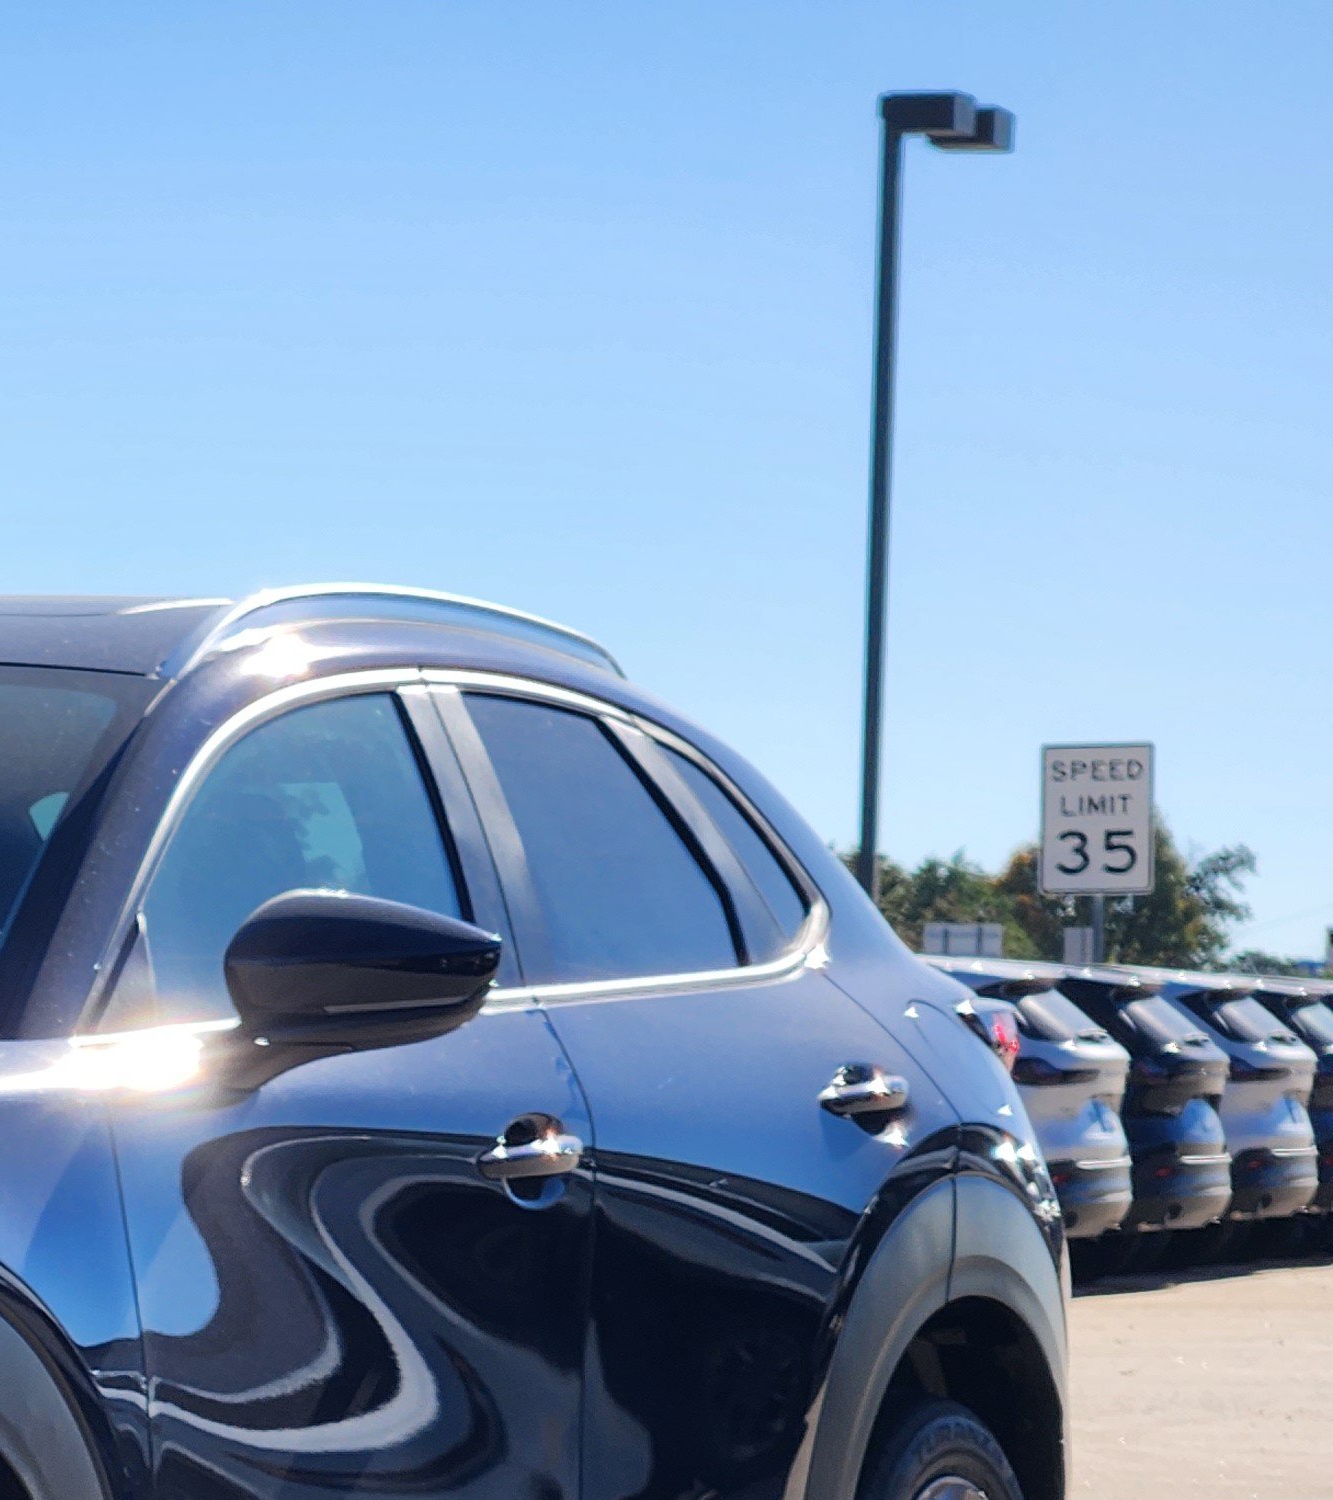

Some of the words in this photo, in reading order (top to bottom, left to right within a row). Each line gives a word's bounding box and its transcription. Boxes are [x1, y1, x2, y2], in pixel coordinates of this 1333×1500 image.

[1051, 759, 1144, 782] SPEED
[1060, 794, 1132, 817] LIMIT
[1056, 830, 1137, 876] 35
